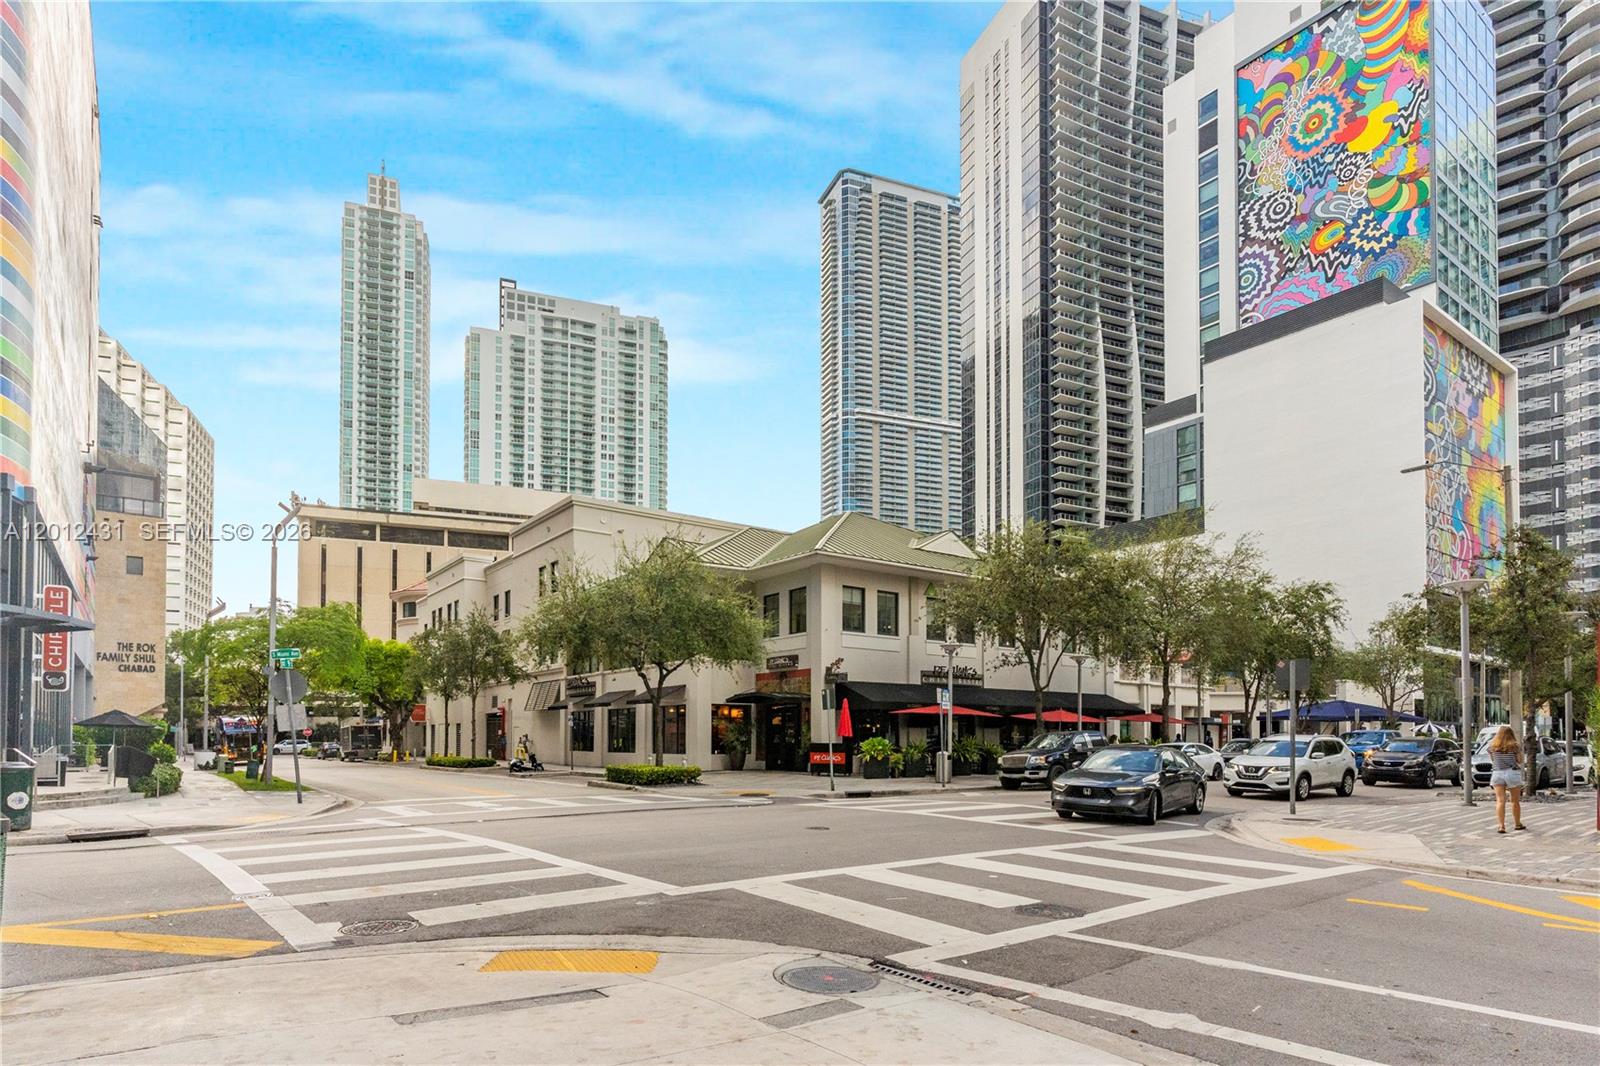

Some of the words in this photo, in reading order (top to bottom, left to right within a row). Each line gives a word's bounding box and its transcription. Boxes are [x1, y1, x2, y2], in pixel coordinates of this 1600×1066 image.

[48, 590, 64, 667] CHIPLE
[117, 642, 134, 652] THE
[136, 643, 156, 653] ROK
[96, 652, 130, 662] FAMILY
[133, 653, 156, 663] SHUL
[118, 664, 156, 673] CHABAD
